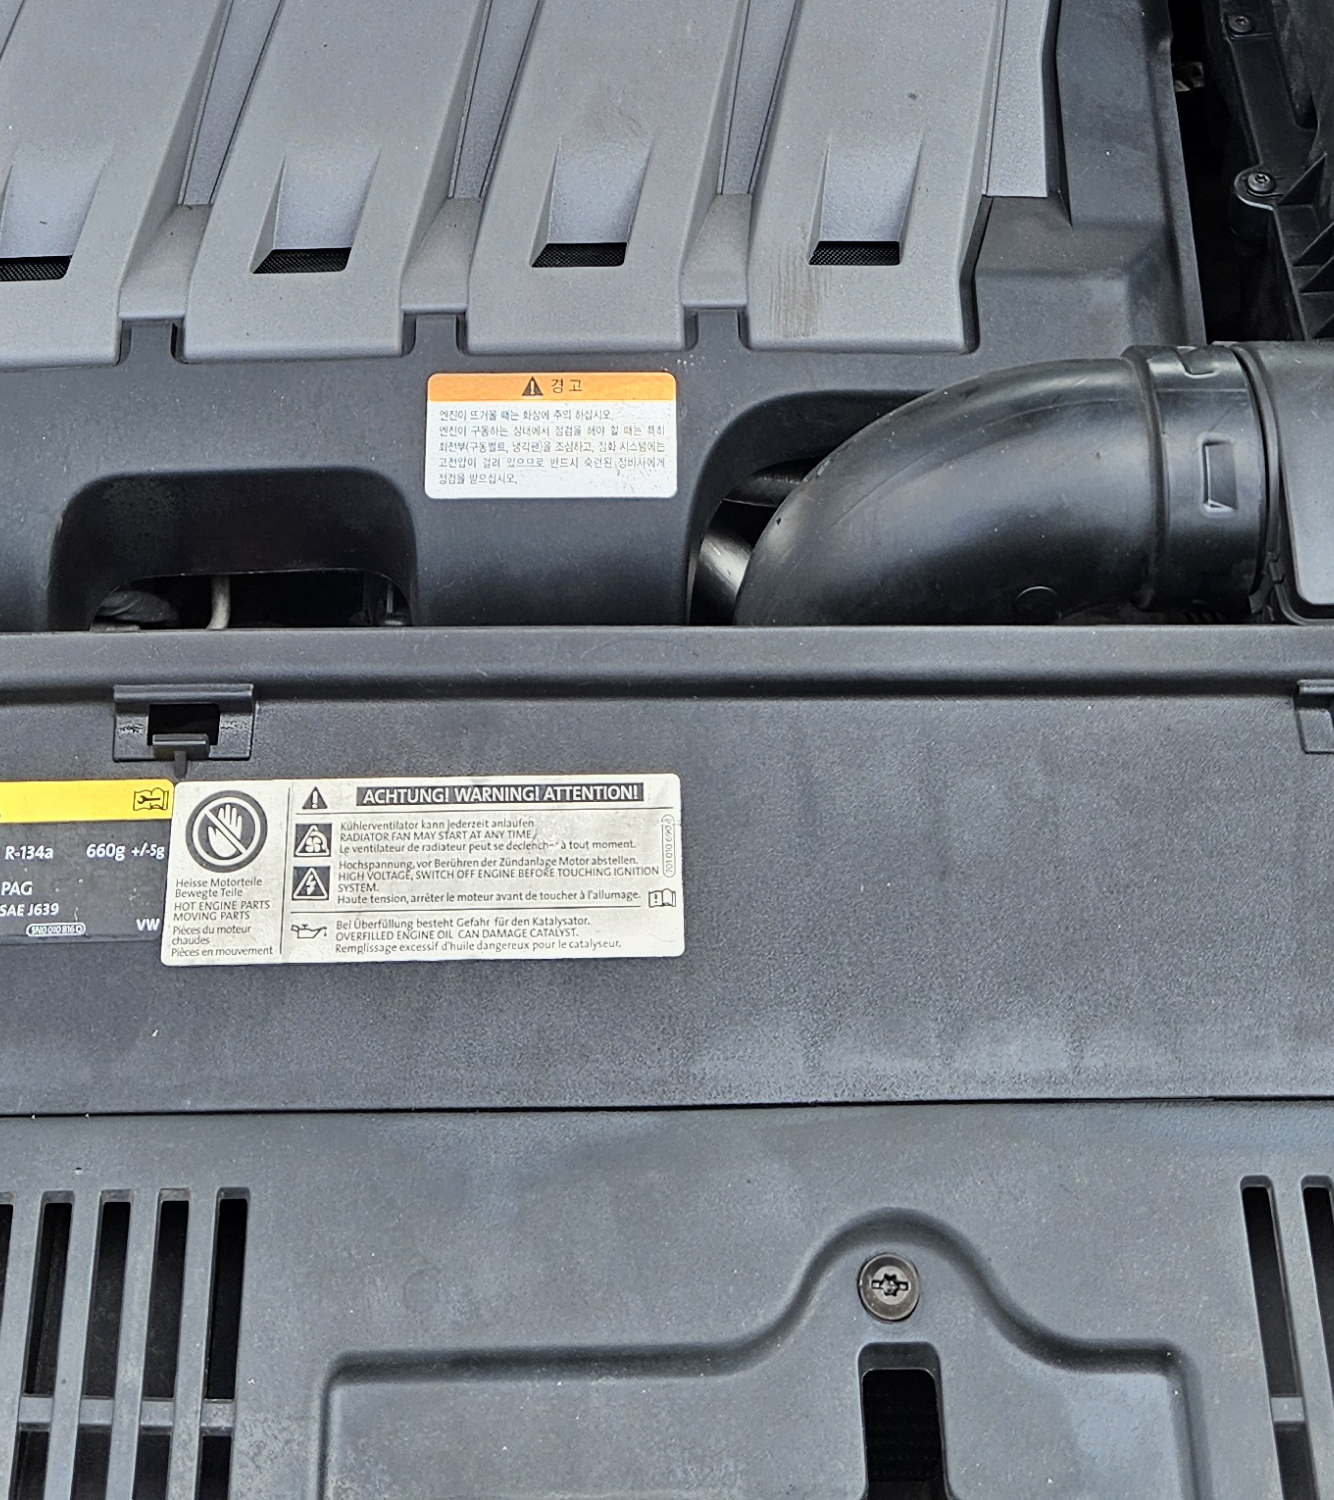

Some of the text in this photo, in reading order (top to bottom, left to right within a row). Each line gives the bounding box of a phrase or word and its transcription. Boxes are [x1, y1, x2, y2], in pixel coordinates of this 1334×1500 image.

[439, 410, 466, 421] 엔진이
[470, 410, 497, 421] 뜨거울
[554, 410, 571, 420] 주의
[439, 426, 466, 437] 엔진이
[471, 426, 508, 437] 구동하는
[507, 457, 545, 468] 있으므로
[550, 457, 579, 468] 반드시
[362, 785, 639, 804] ACHTUNG! WARNING! ATTENTION!
[340, 821, 418, 831] Kühlerventilator
[421, 820, 444, 830] kann
[446, 819, 489, 832] jederzeit
[340, 830, 505, 842] RADIATOR FAN MAY START AT ANY
[4, 842, 166, 862] R-134a 660g +/-5g
[339, 844, 350, 853] Le
[351, 843, 405, 853] ventilateur
[407, 843, 419, 852] de
[421, 842, 466, 852] radiateur
[469, 842, 491, 853] peut
[560, 840, 566, 849] à
[569, 841, 590, 850] tout
[592, 840, 637, 849] moment.
[339, 856, 639, 871] Hochspannung, vor Berühren der Zündanlage Motor abstellen.
[338, 866, 659, 881] HIGH VOLTAGE, SWITCH OFF ENGINE BEFORE TOUCHING IGNITION
[1, 881, 33, 896] PAG
[175, 877, 263, 888] Heisse Motorteile
[338, 883, 379, 892] SYSTEM.
[175, 887, 243, 900] Bewegte Teile
[337, 890, 641, 904] Haute tension, arrêter le moteur avant de toucher à l'allumage.
[27, 903, 60, 917] J639
[174, 900, 270, 911] HOT ENGINE PARTS
[173, 911, 250, 921] MOVING PARTS
[136, 918, 160, 931] VW
[172, 925, 251, 936] Pièces du moteur
[336, 916, 590, 932] Bei Überfüllung besteht Gefahr für den Katalysator.
[171, 935, 210, 945] chaudes
[336, 928, 579, 941] OVERFILLED ENGINE OIL CAN DAMAGE CATALYST.
[171, 946, 273, 957] Pièces en mouvement
[336, 939, 622, 955] Remplissage excessif d'huile dangereux pour le catalyseur.
